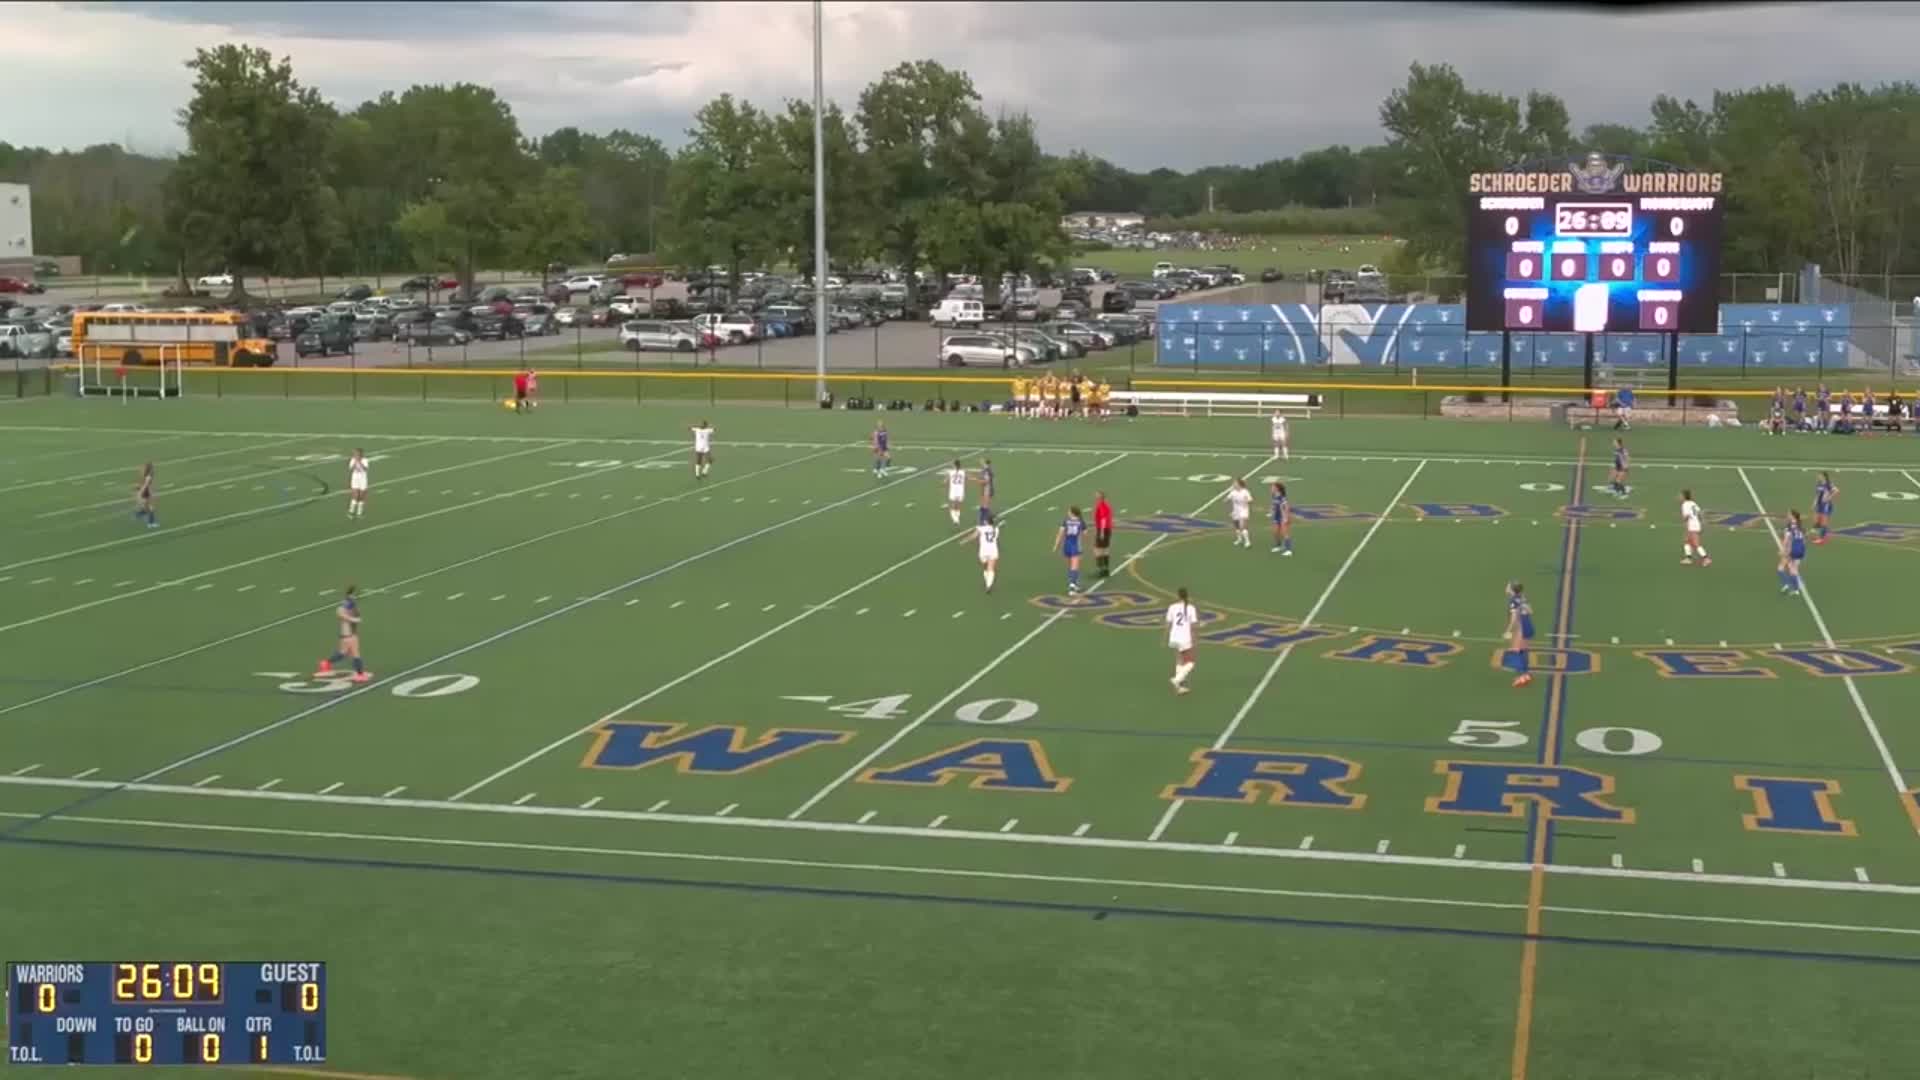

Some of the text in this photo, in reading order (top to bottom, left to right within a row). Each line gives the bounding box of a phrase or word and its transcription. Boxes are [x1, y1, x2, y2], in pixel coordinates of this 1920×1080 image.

[1470, 173, 1722, 193] SCHROEDER WARRIORS
[1505, 217, 1519, 236] 0
[1559, 211, 1629, 230] 26:09
[1670, 217, 1684, 236] 0
[1519, 259, 1533, 277] 0
[1561, 259, 1576, 277] 0
[1612, 258, 1626, 277] 0
[1657, 258, 1671, 277] 0
[1519, 305, 1533, 324] 0
[1655, 307, 1668, 325] 0
[828, 693, 1039, 725] 40
[1448, 719, 1662, 756] 50
[579, 719, 1920, 837] WARRI
